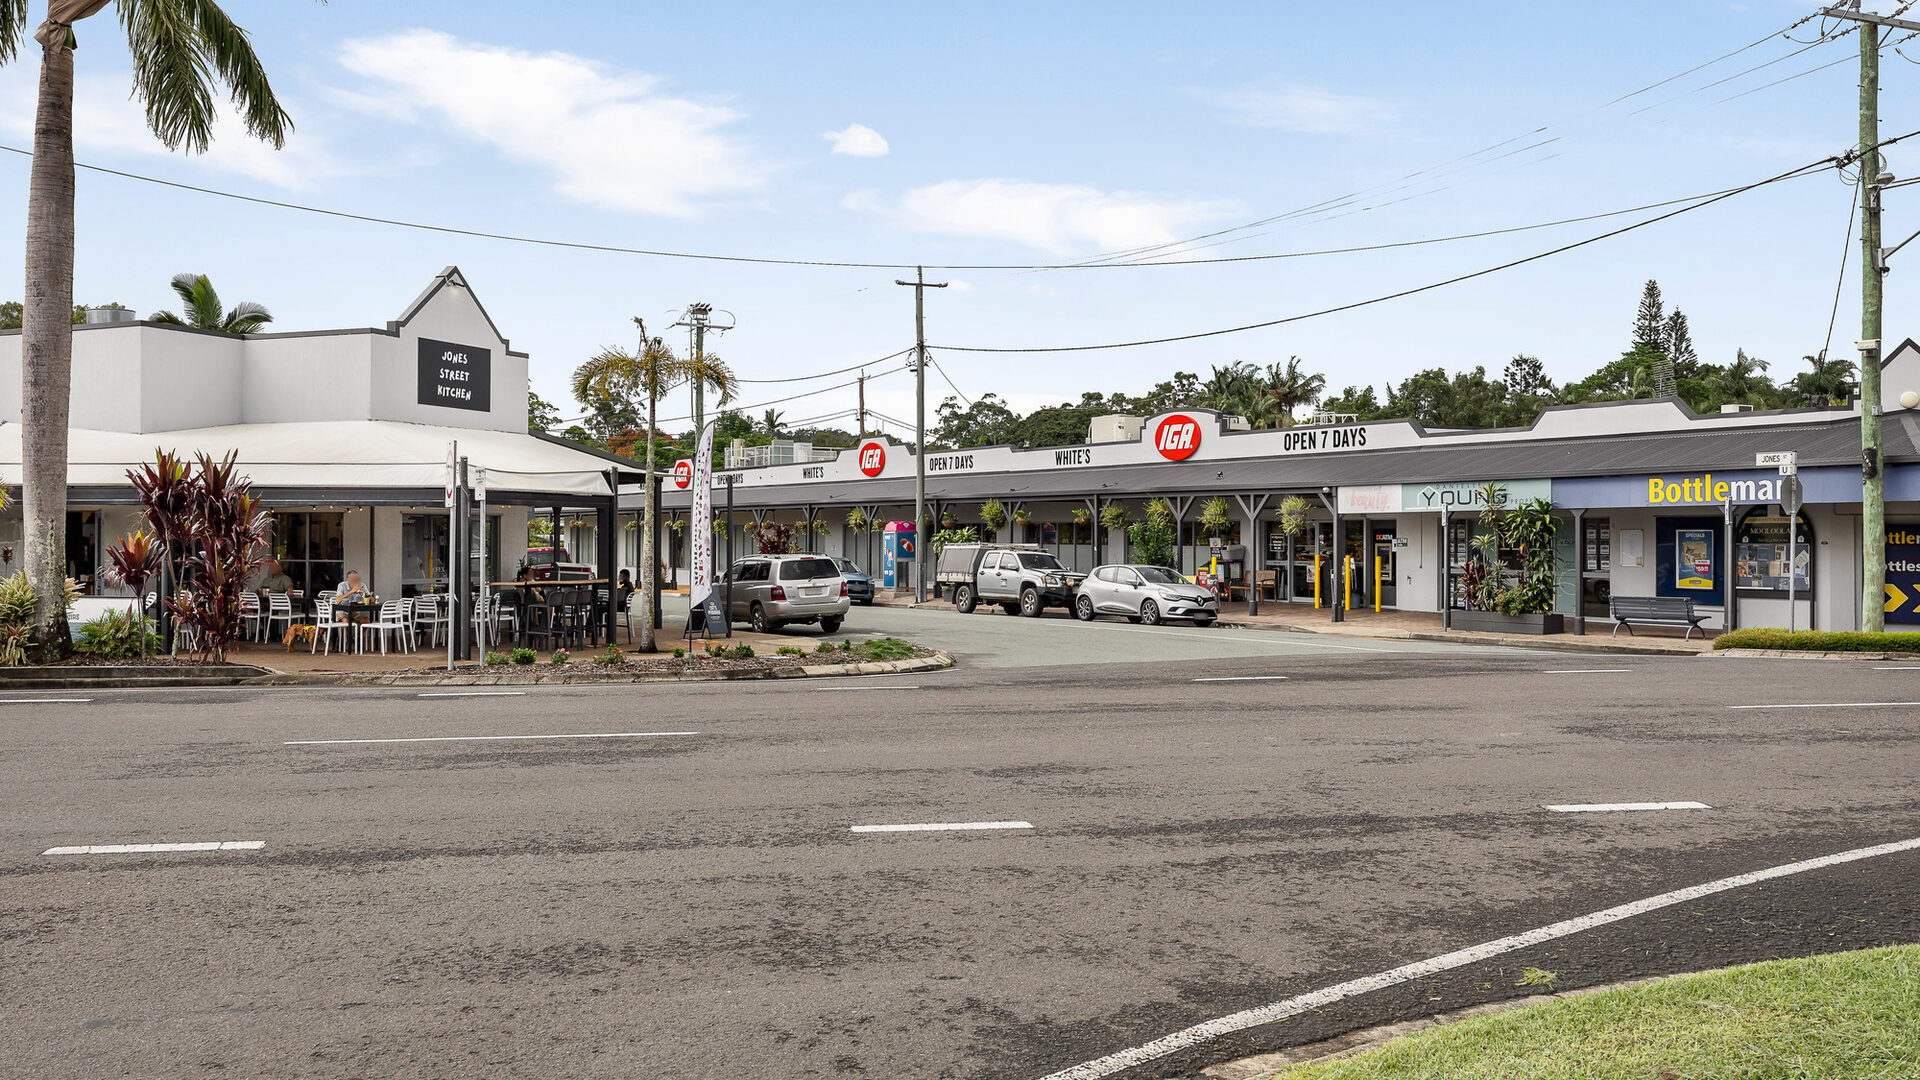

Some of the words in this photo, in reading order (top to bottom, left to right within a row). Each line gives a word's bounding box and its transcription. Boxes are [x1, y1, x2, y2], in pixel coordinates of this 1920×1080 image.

[442, 351, 468, 364] JONES
[440, 368, 469, 381] STREET
[437, 385, 472, 401] KITCHEN
[1159, 423, 1195, 450] IGA
[1284, 432, 1316, 451] OPEN
[1321, 431, 1328, 449] 7
[1333, 427, 1366, 448] DAYS
[861, 449, 881, 470] IGA
[929, 457, 947, 471] OPEN
[949, 457, 954, 470] 7
[955, 455, 974, 470] DAYS
[1055, 449, 1091, 466] WHITE'S
[1762, 455, 1781, 463] JONES
[803, 467, 824, 480] WHITE'S
[1422, 489, 1508, 507] YOUNG
